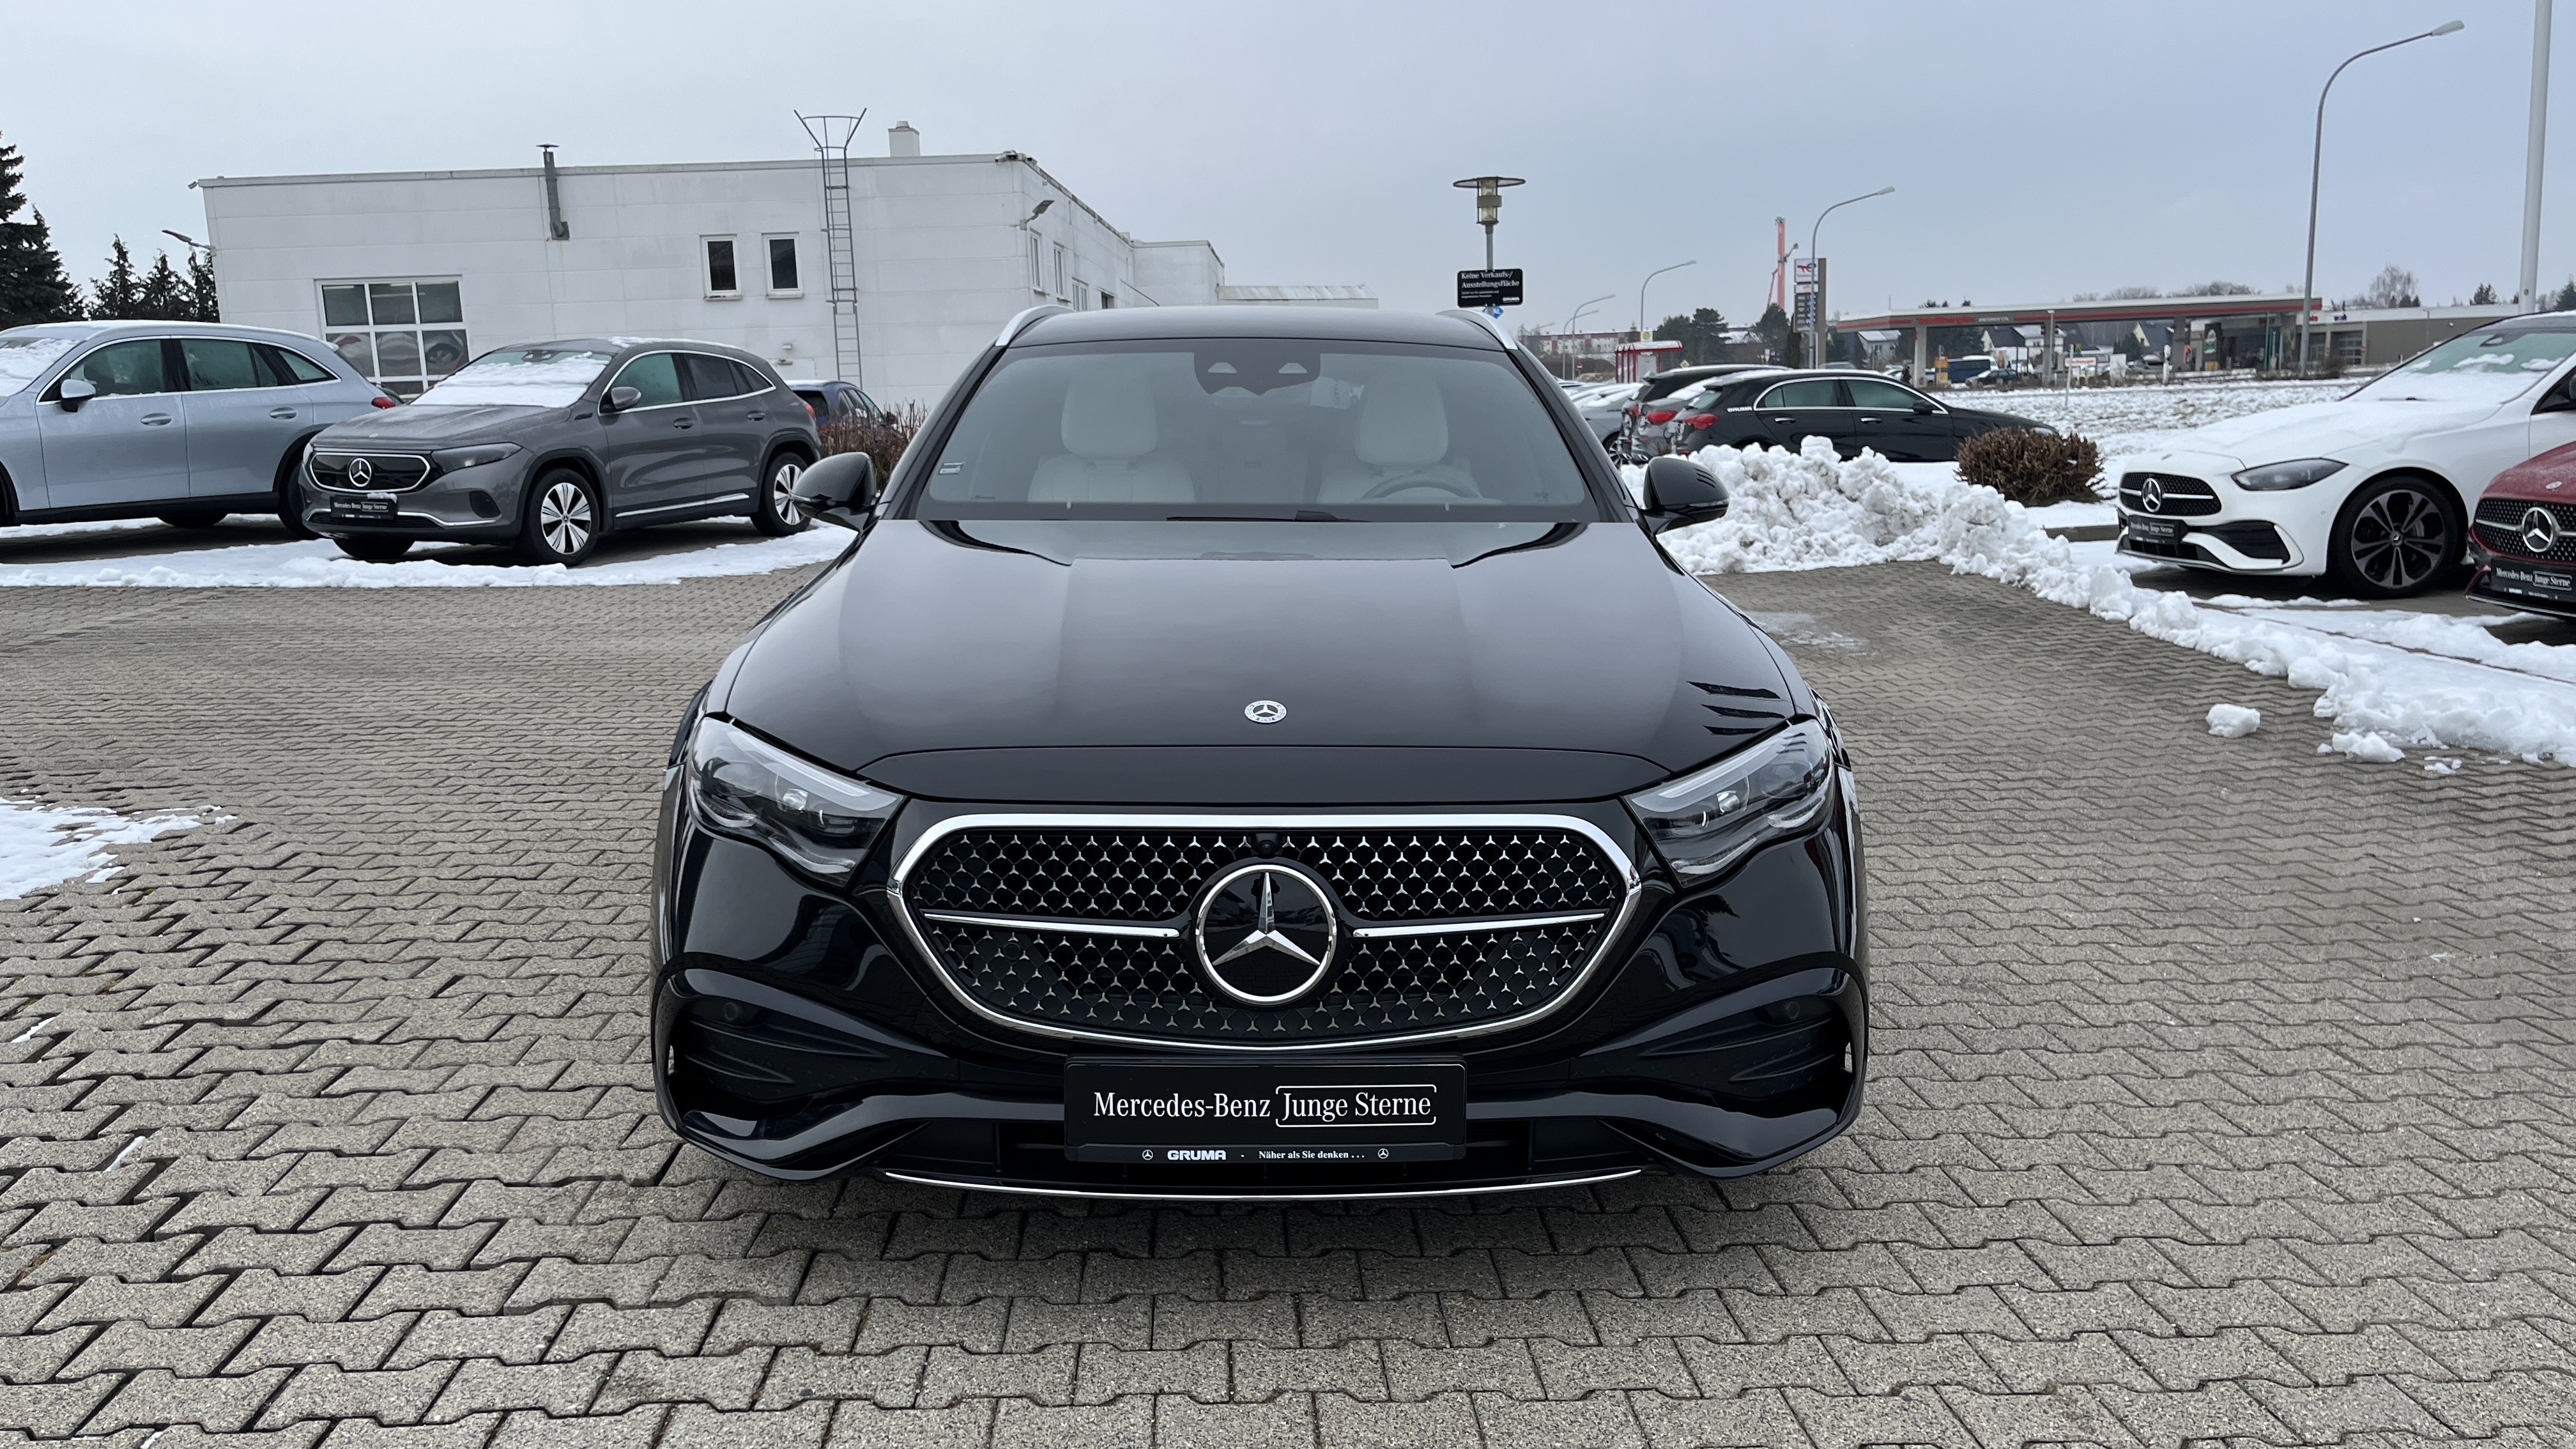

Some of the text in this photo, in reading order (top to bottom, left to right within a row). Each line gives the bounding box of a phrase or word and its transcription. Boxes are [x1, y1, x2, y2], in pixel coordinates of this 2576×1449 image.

[1461, 280, 1520, 289] Ausstellungsfläche
[1093, 1092, 1431, 1123] Mercedes-Benz Junge Sterne
[1167, 1150, 1227, 1161] GRUMA
[1259, 1151, 1285, 1159] Näher
[1287, 1151, 1300, 1159] als
[1301, 1151, 1315, 1159] Sie
